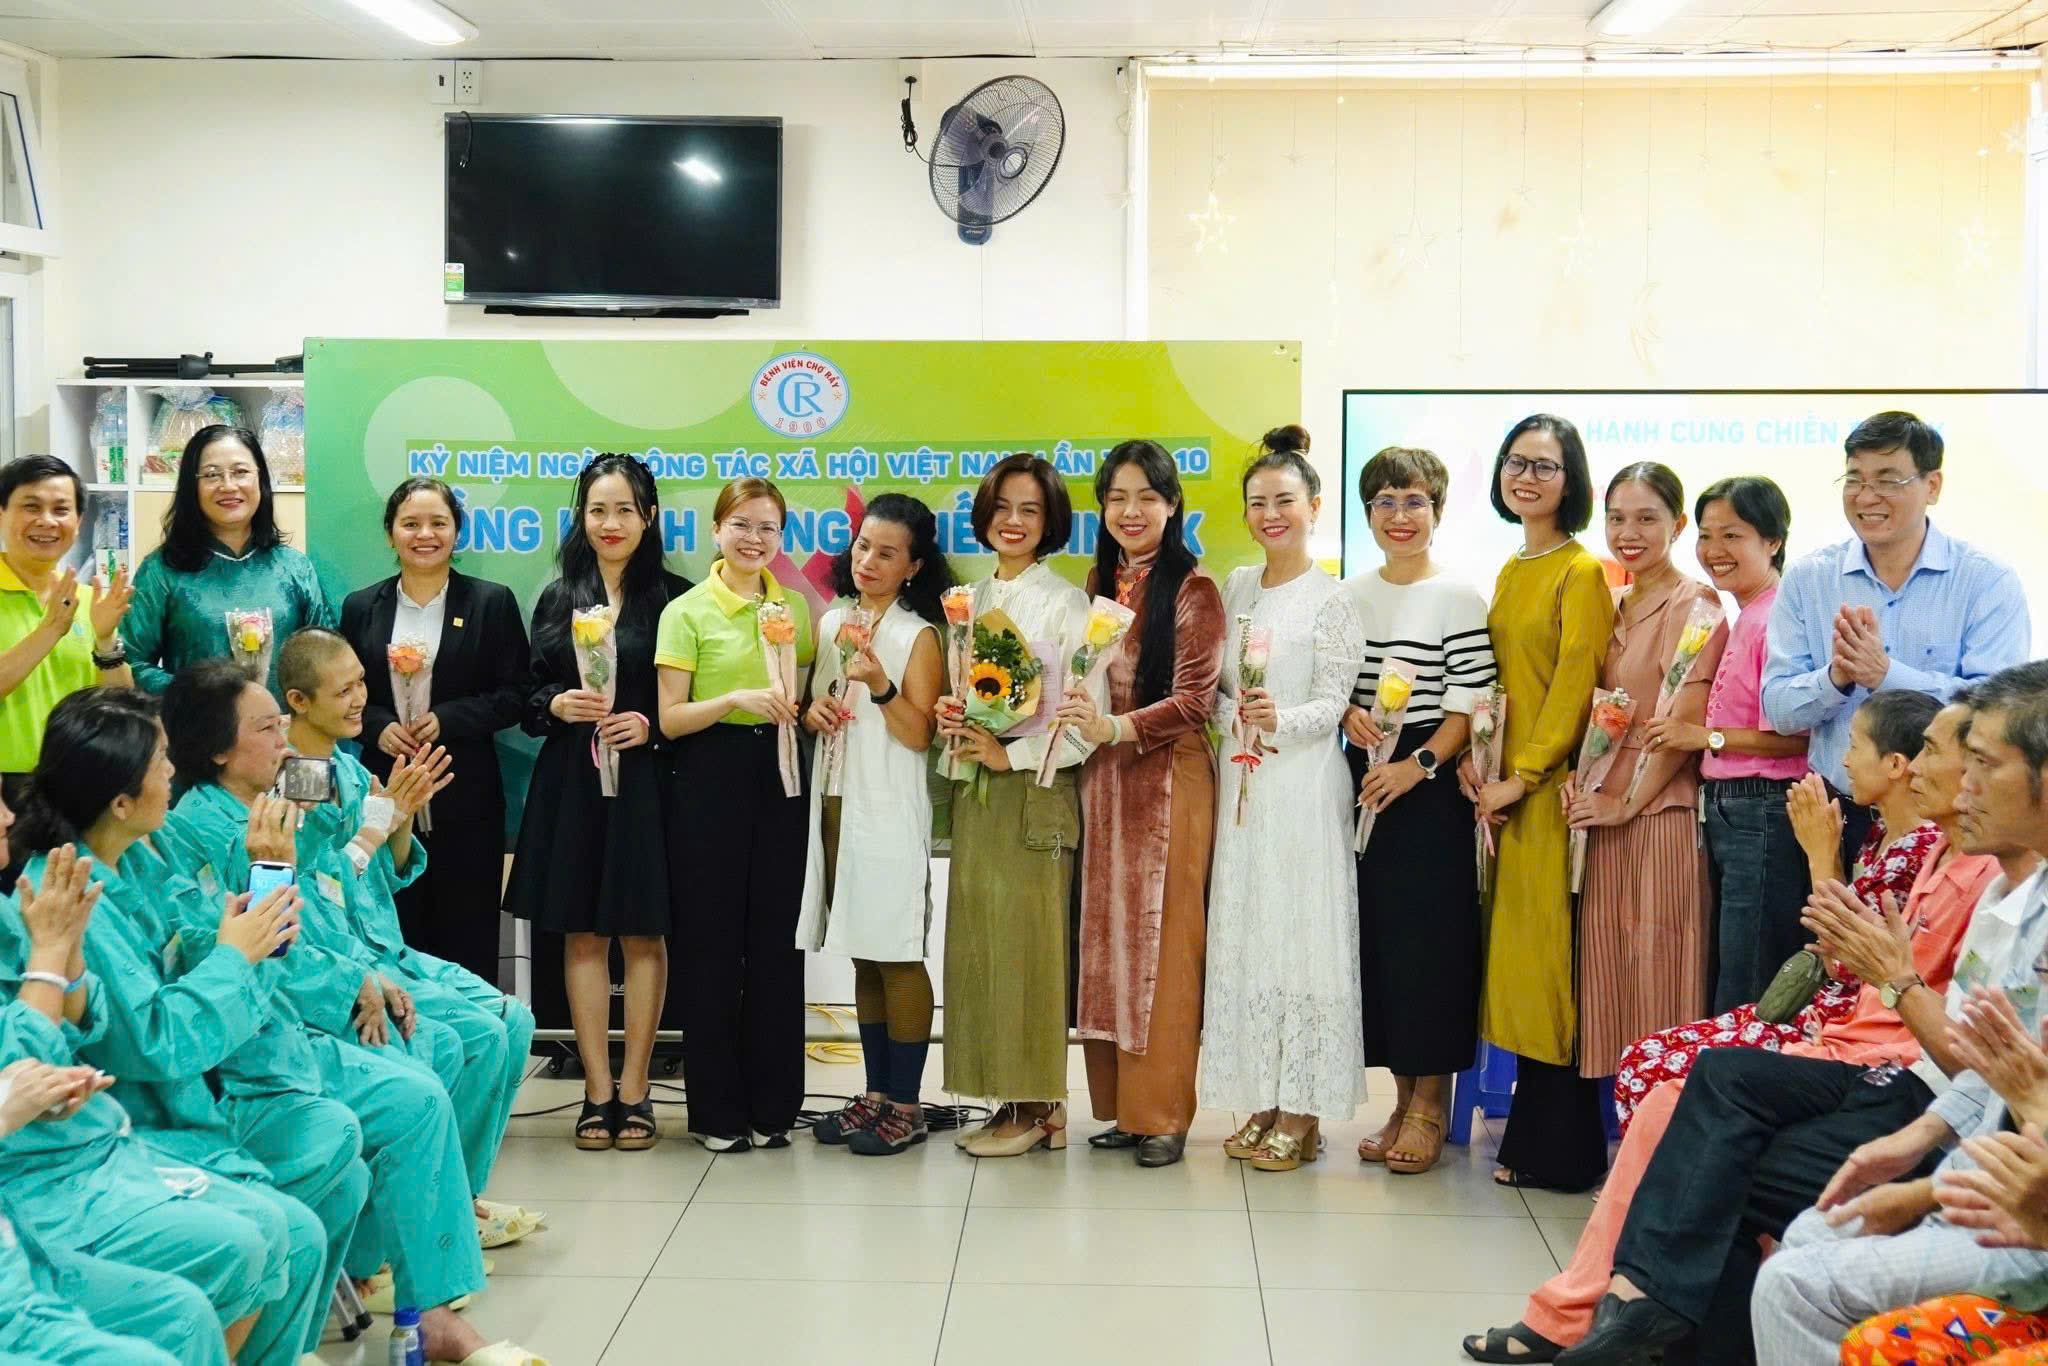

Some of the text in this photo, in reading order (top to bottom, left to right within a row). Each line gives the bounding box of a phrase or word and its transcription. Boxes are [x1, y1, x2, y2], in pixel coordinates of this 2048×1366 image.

[775, 416, 827, 433] 1900
[410, 444, 450, 475] KỶ
[459, 447, 530, 482] NIỆM
[633, 448, 705, 478] ÔNG
[715, 450, 770, 478] TÁC
[777, 449, 820, 478] XÃ
[828, 448, 877, 483] HỘI
[886, 447, 952, 483] VIỆT
[961, 452, 1010, 476] NA
[1036, 441, 1093, 475] ẦN
[1173, 448, 1208, 473] 10
